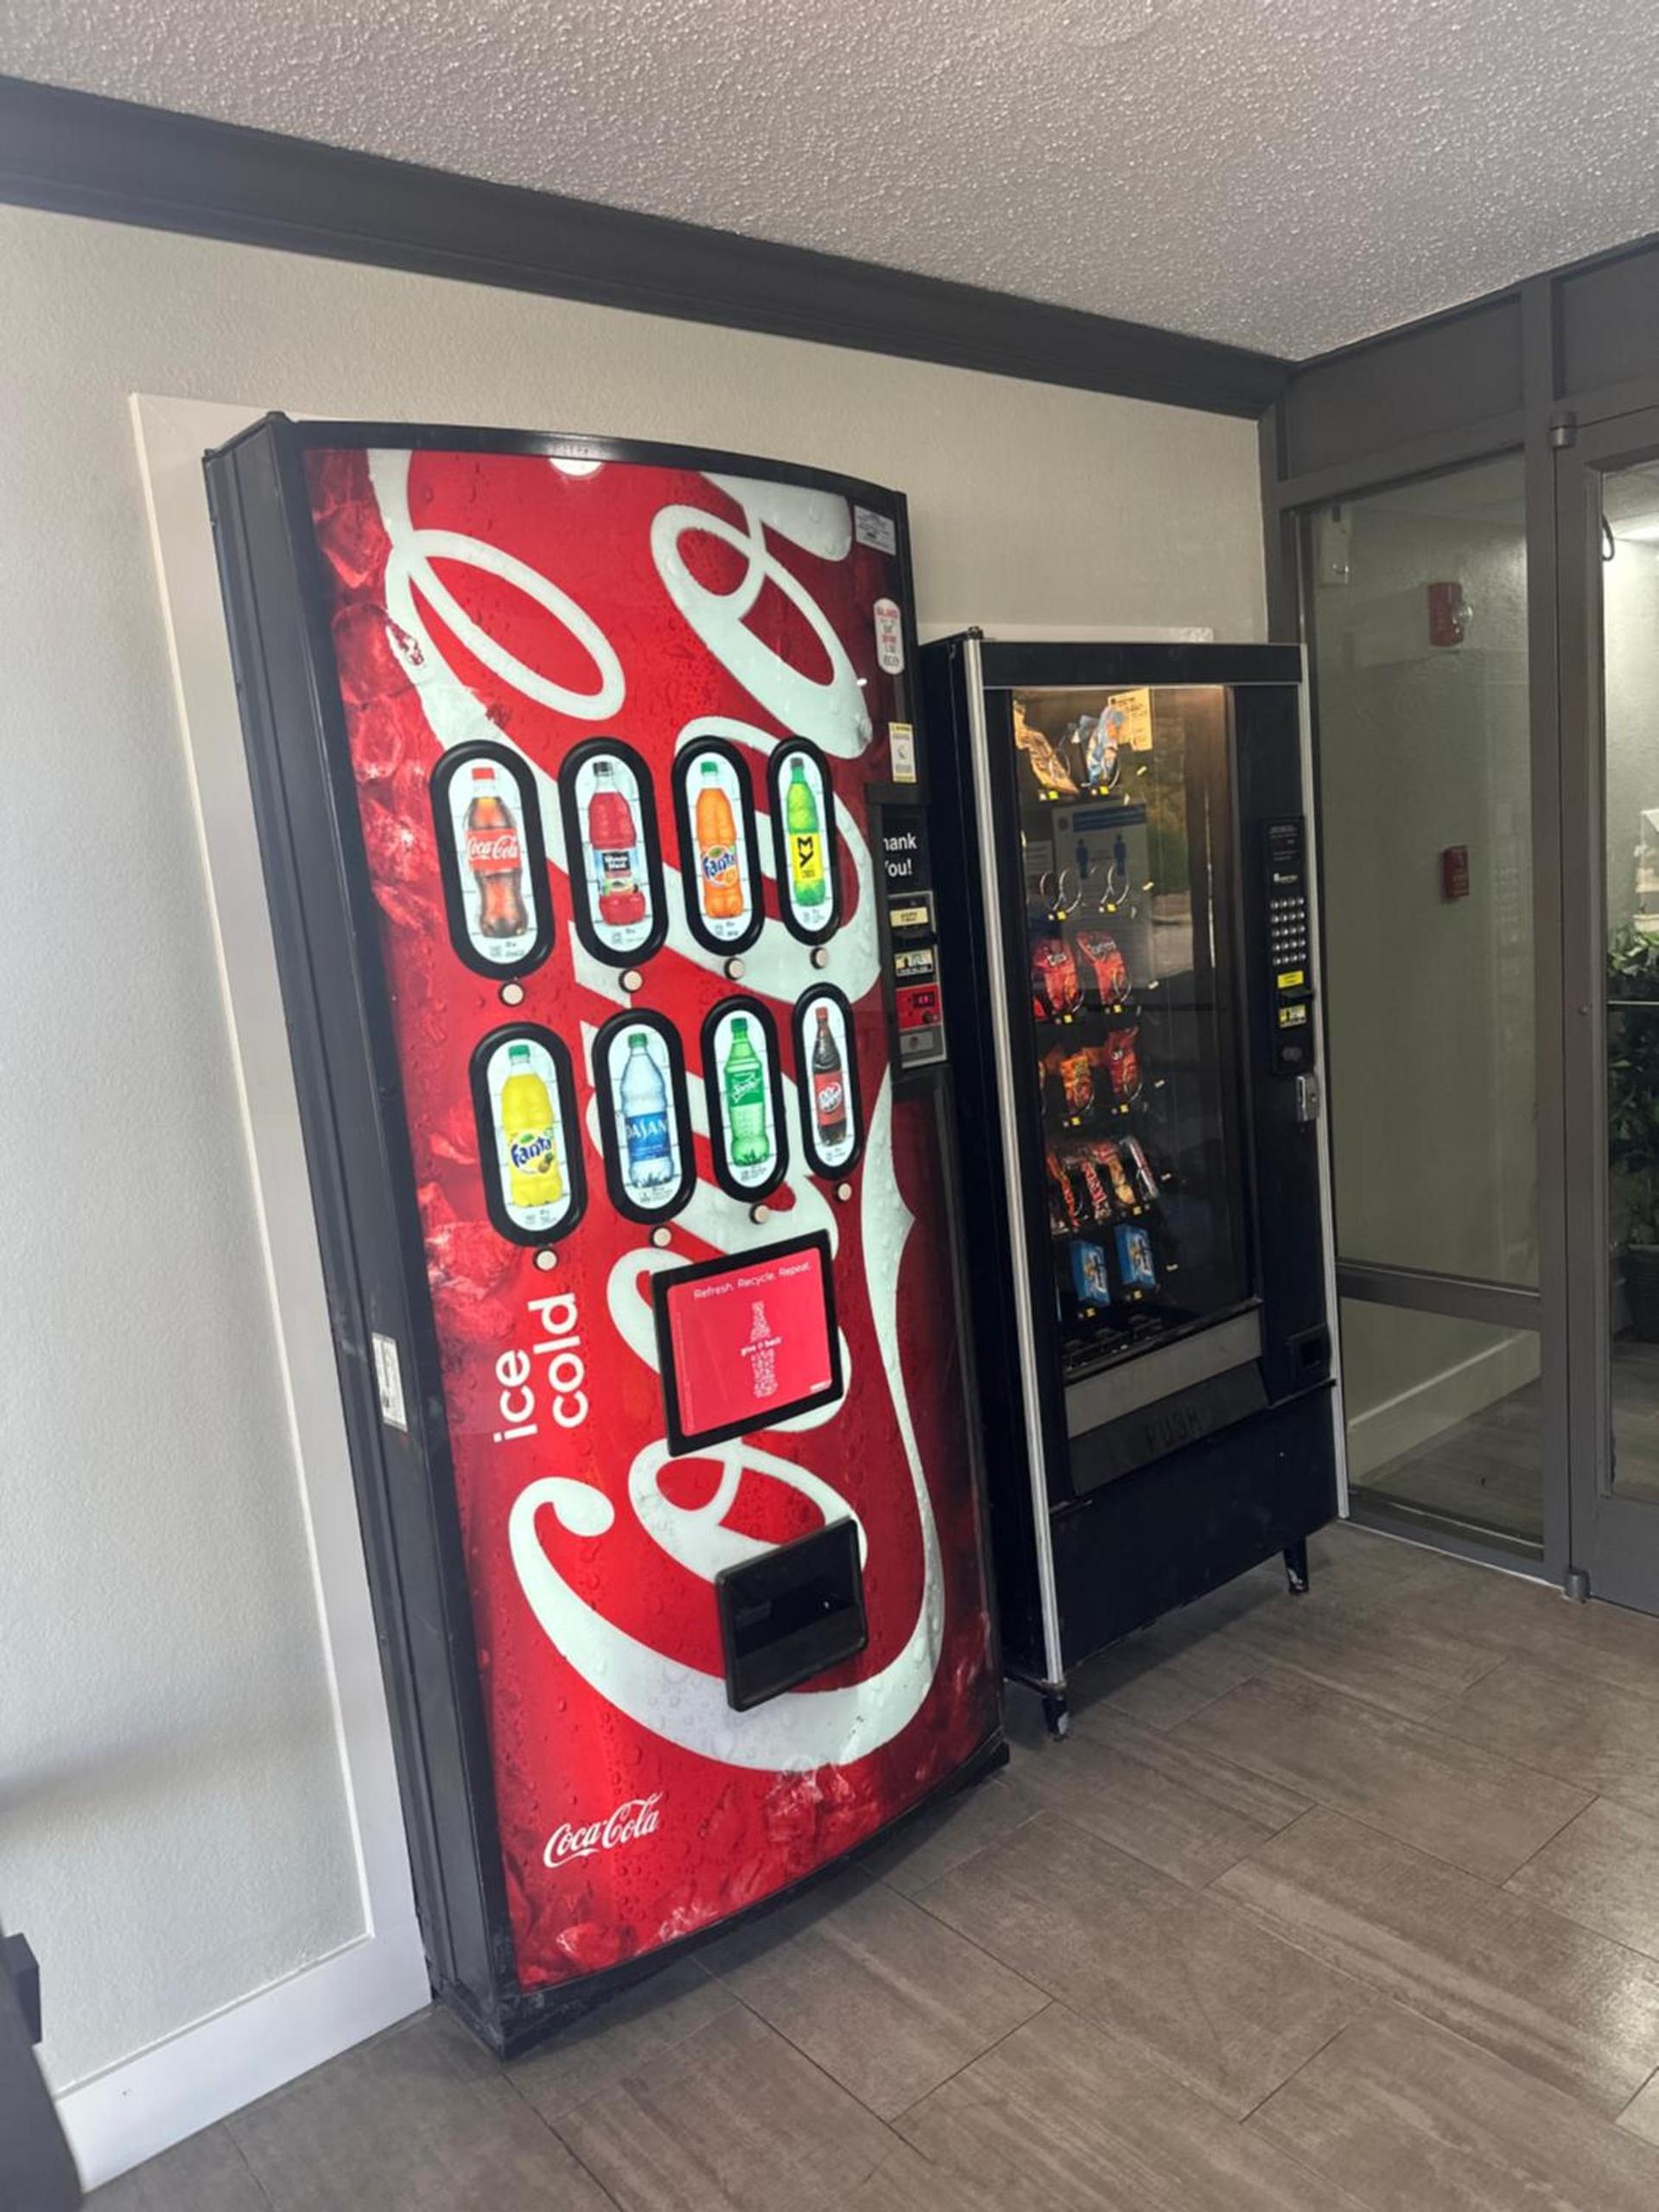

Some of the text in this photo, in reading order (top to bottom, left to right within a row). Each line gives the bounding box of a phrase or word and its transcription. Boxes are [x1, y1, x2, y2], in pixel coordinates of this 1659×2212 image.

[511, 1136, 551, 1168] Fanta
[493, 1349, 539, 1444] ice
[527, 1293, 589, 1429] cold
[543, 1790, 664, 1869] Coca-Cola
